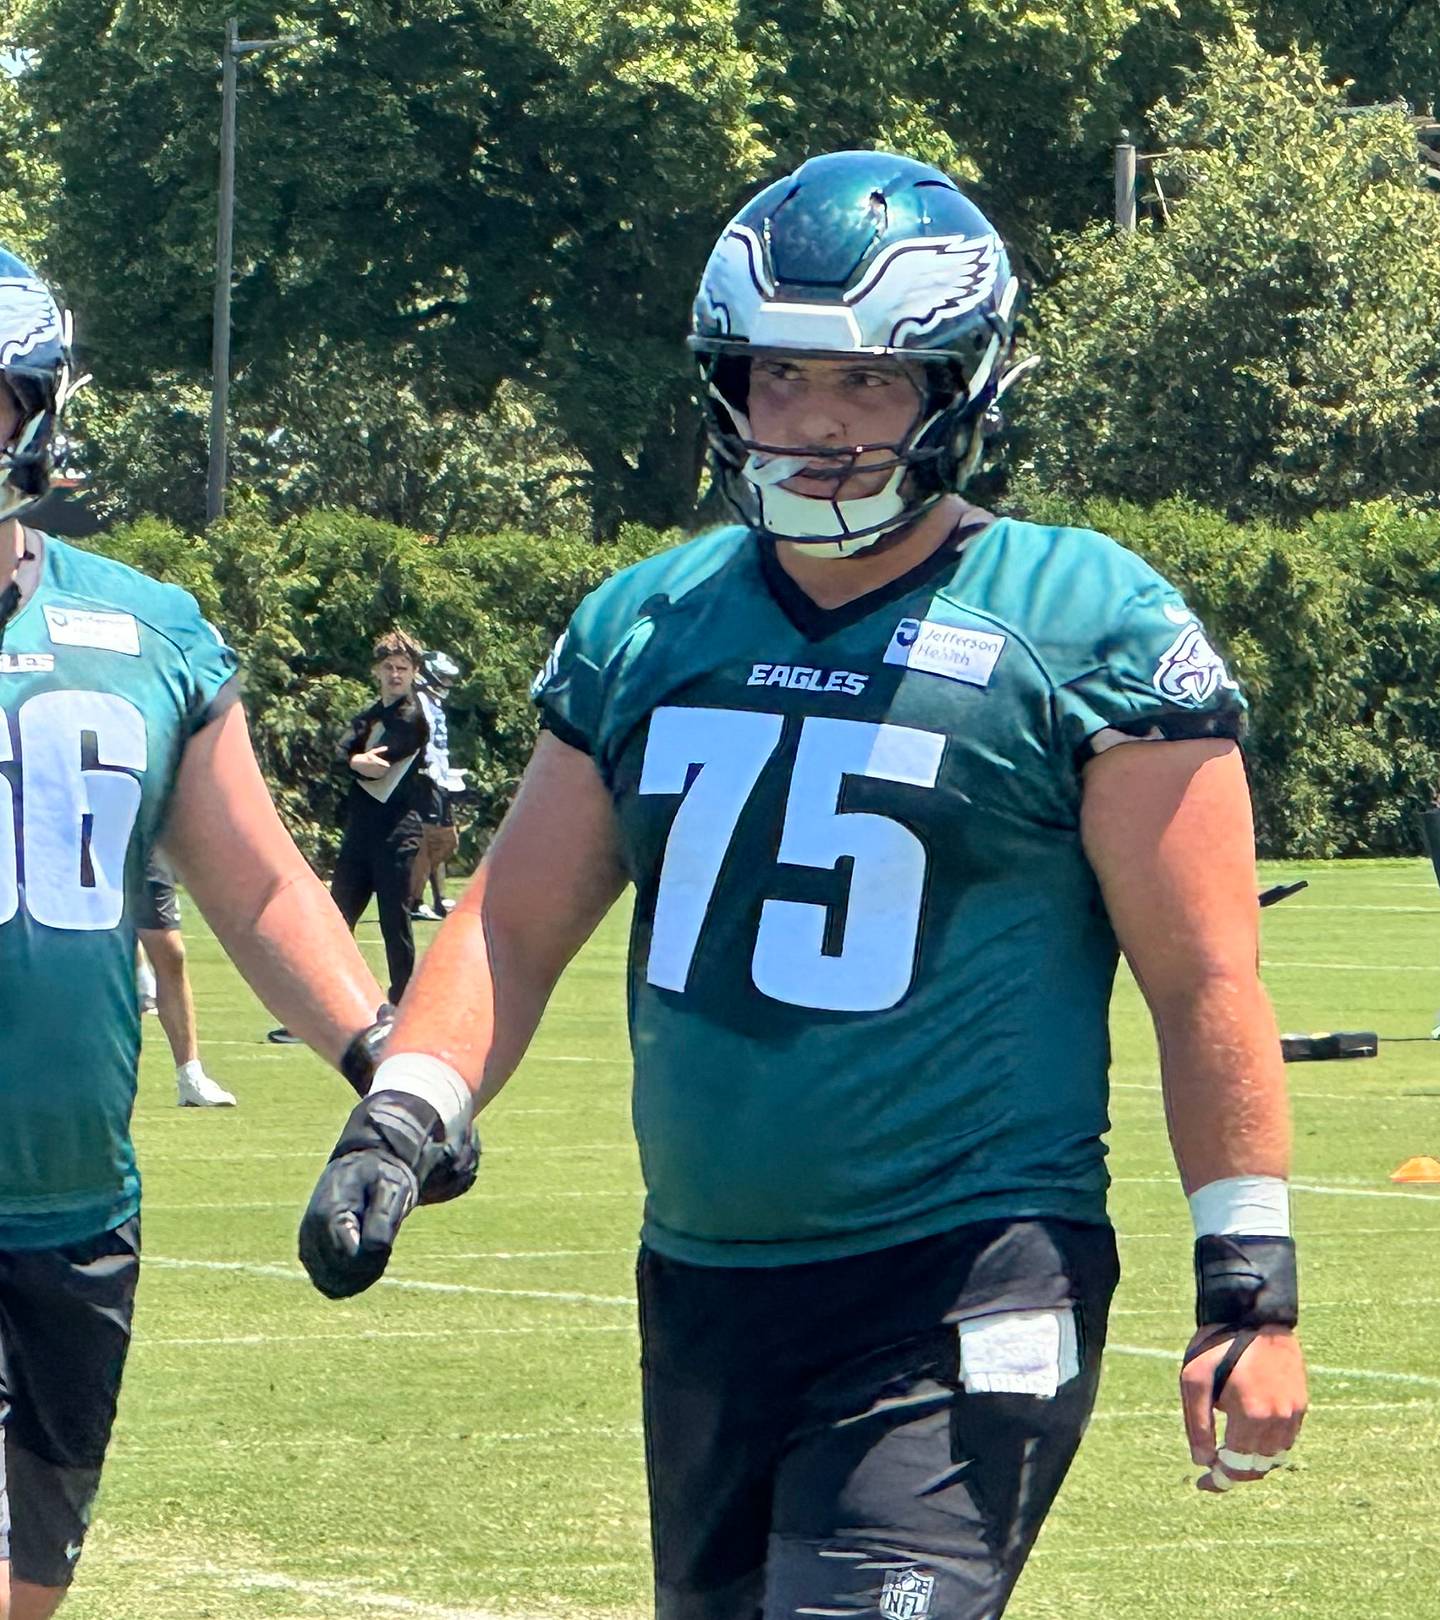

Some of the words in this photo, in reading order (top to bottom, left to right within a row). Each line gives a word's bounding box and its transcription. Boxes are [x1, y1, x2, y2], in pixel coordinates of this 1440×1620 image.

[746, 663, 869, 696] EAGLES
[924, 628, 999, 653] Jefferson
[0, 689, 148, 931] 6
[638, 706, 947, 1012] 75
